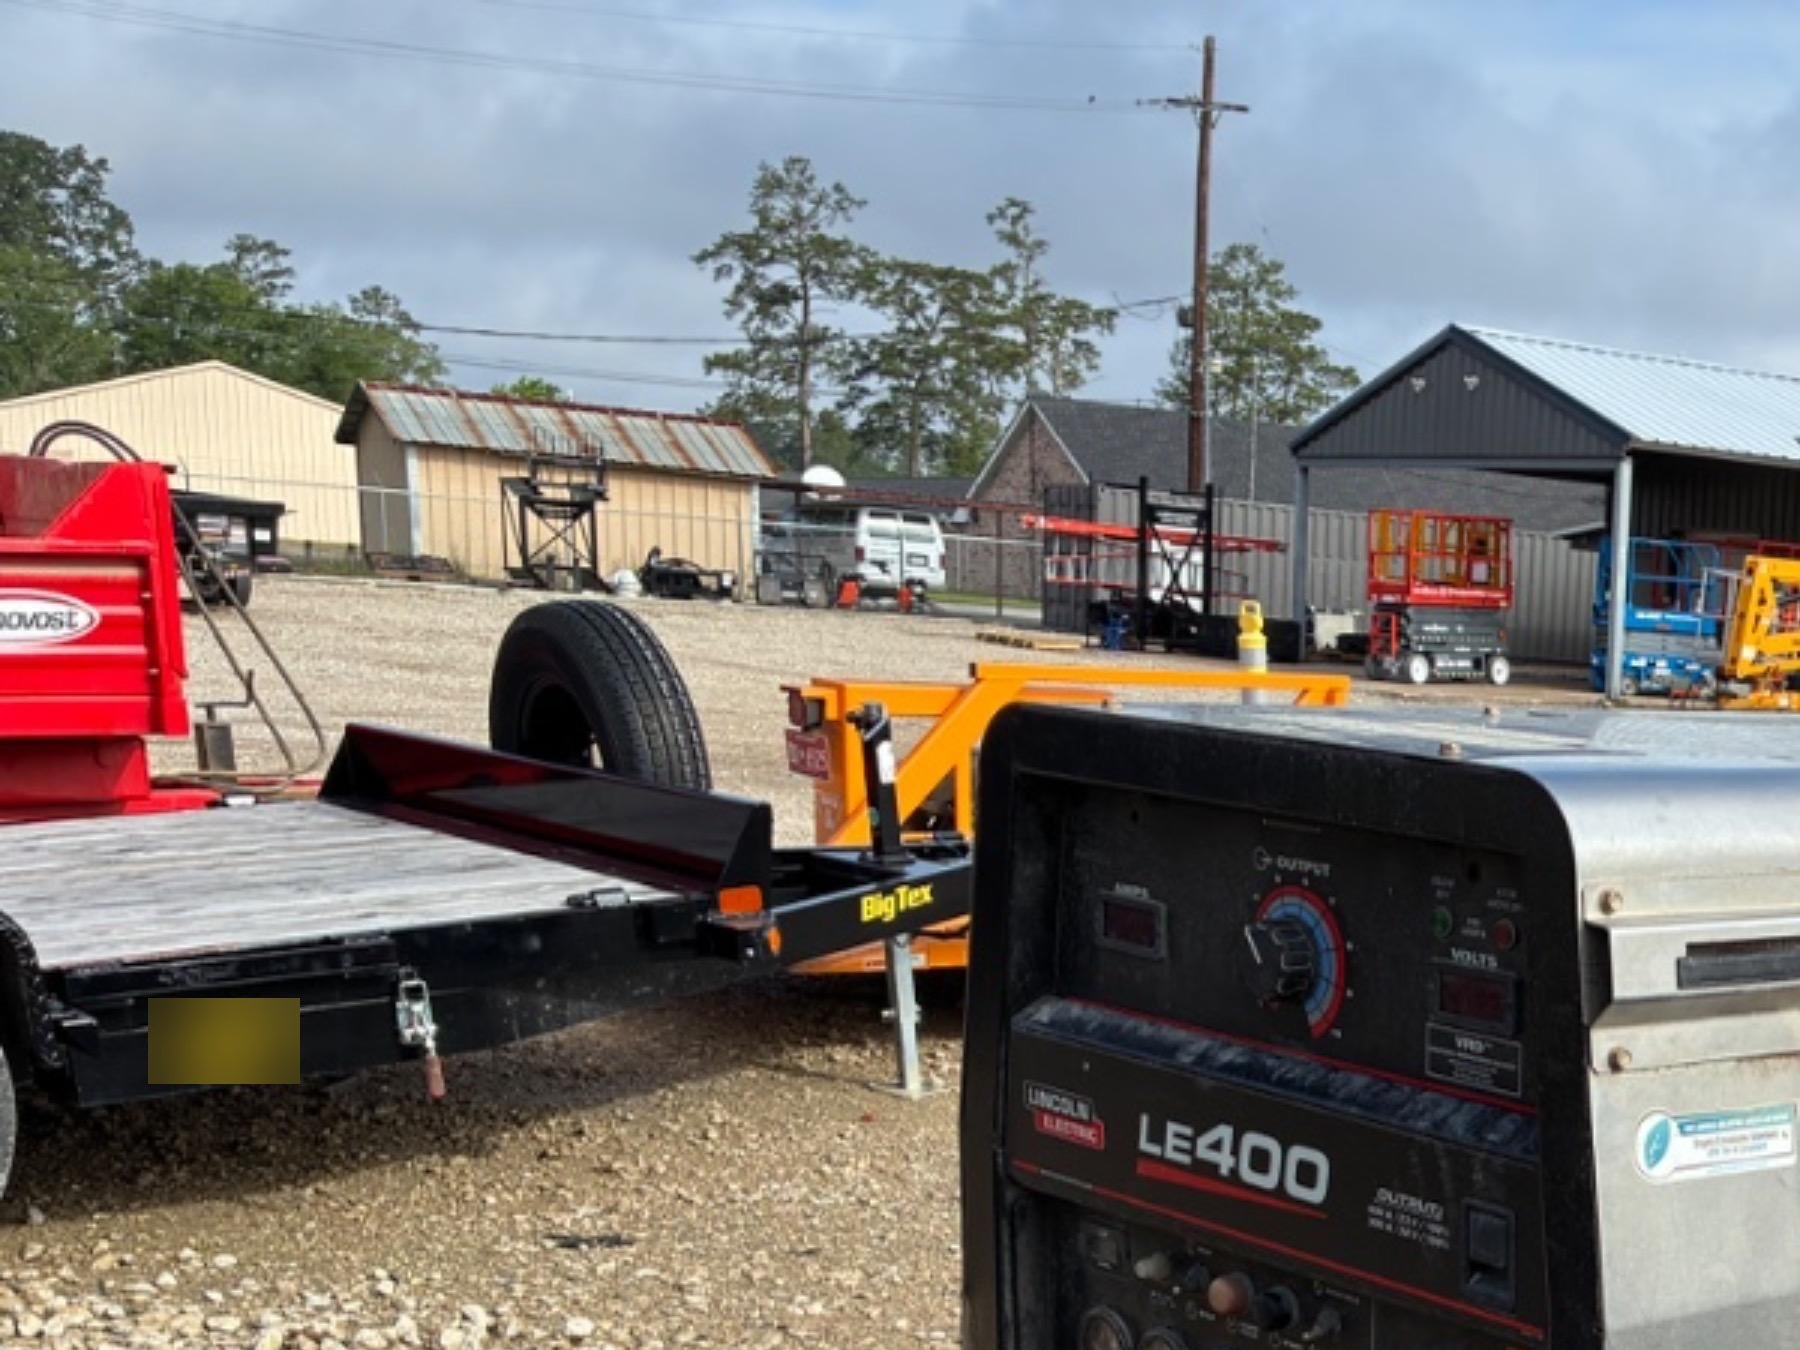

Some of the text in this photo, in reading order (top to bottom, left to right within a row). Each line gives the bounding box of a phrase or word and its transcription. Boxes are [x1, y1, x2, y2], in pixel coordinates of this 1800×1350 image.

[1451, 947, 1498, 969] VOLTS
[1028, 1087, 1091, 1121] LINCOLN
[1043, 1113, 1098, 1144] ELECTRIC
[1138, 1112, 1331, 1205] LE400
